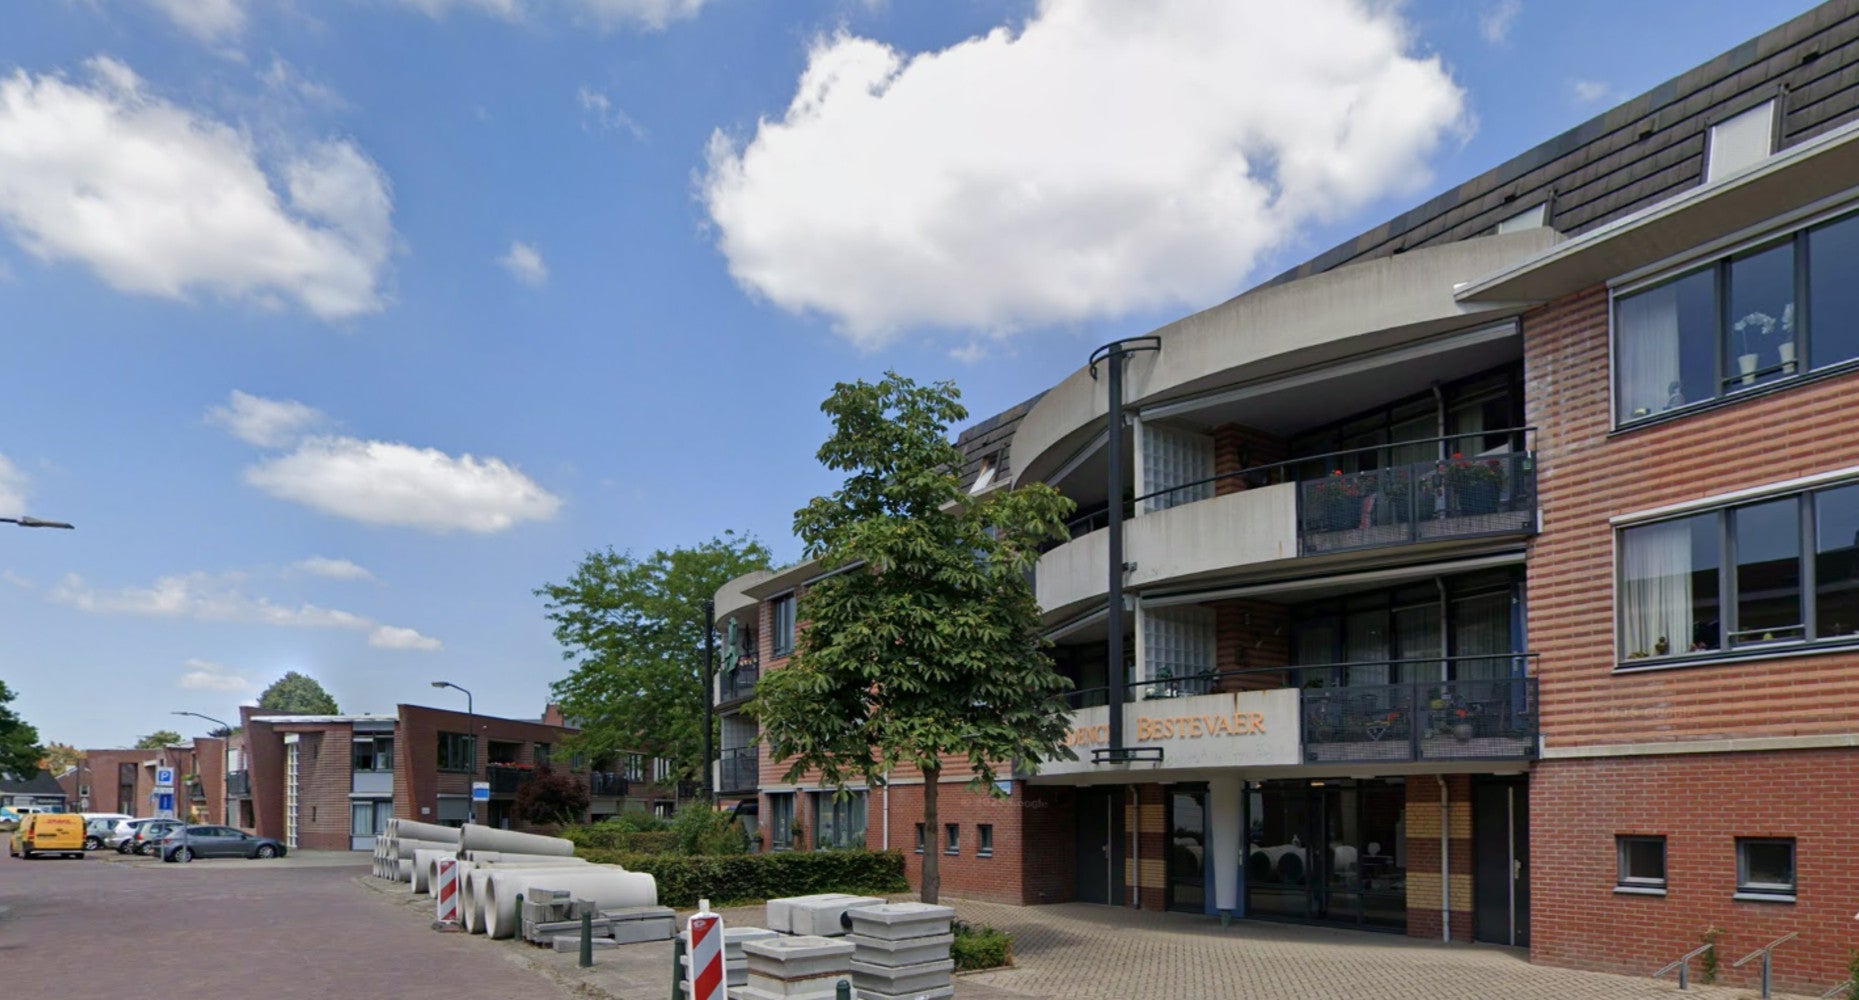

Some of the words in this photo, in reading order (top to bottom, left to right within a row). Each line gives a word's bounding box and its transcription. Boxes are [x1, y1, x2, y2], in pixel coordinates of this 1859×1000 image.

[1063, 724, 1110, 746] DENC
[1136, 711, 1266, 741] BESTEVAER
[160, 771, 169, 780] P
